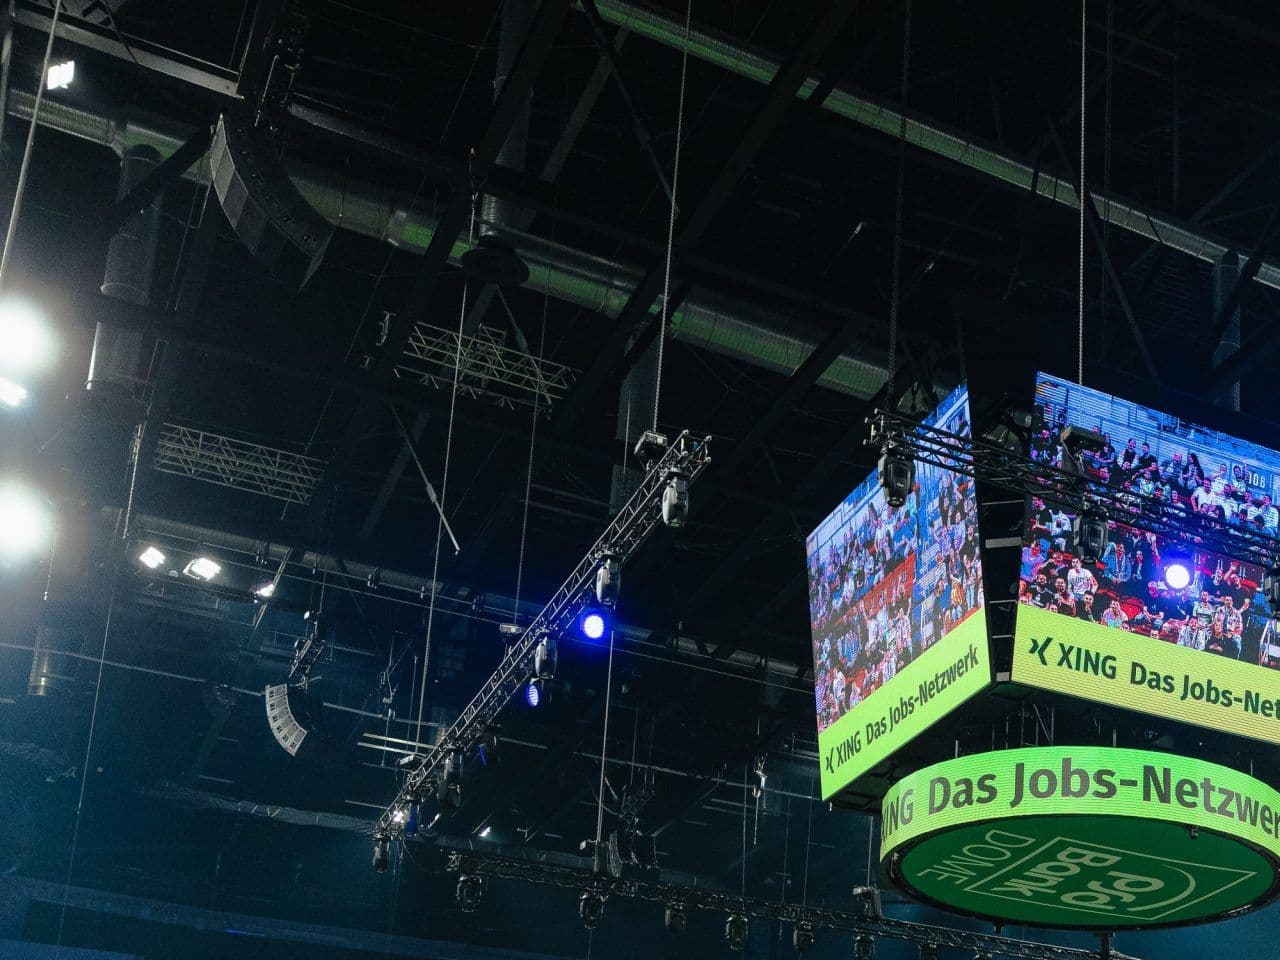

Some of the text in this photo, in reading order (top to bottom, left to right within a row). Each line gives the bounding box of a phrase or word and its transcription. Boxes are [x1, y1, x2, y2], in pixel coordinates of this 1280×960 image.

[1057, 642, 1118, 679] XING
[1130, 661, 1175, 694] Das
[836, 643, 979, 768] XING Das Jobs-Netzwerk
[928, 772, 998, 816] Das
[917, 829, 1036, 885] DOME
[996, 846, 1122, 898] Bank
